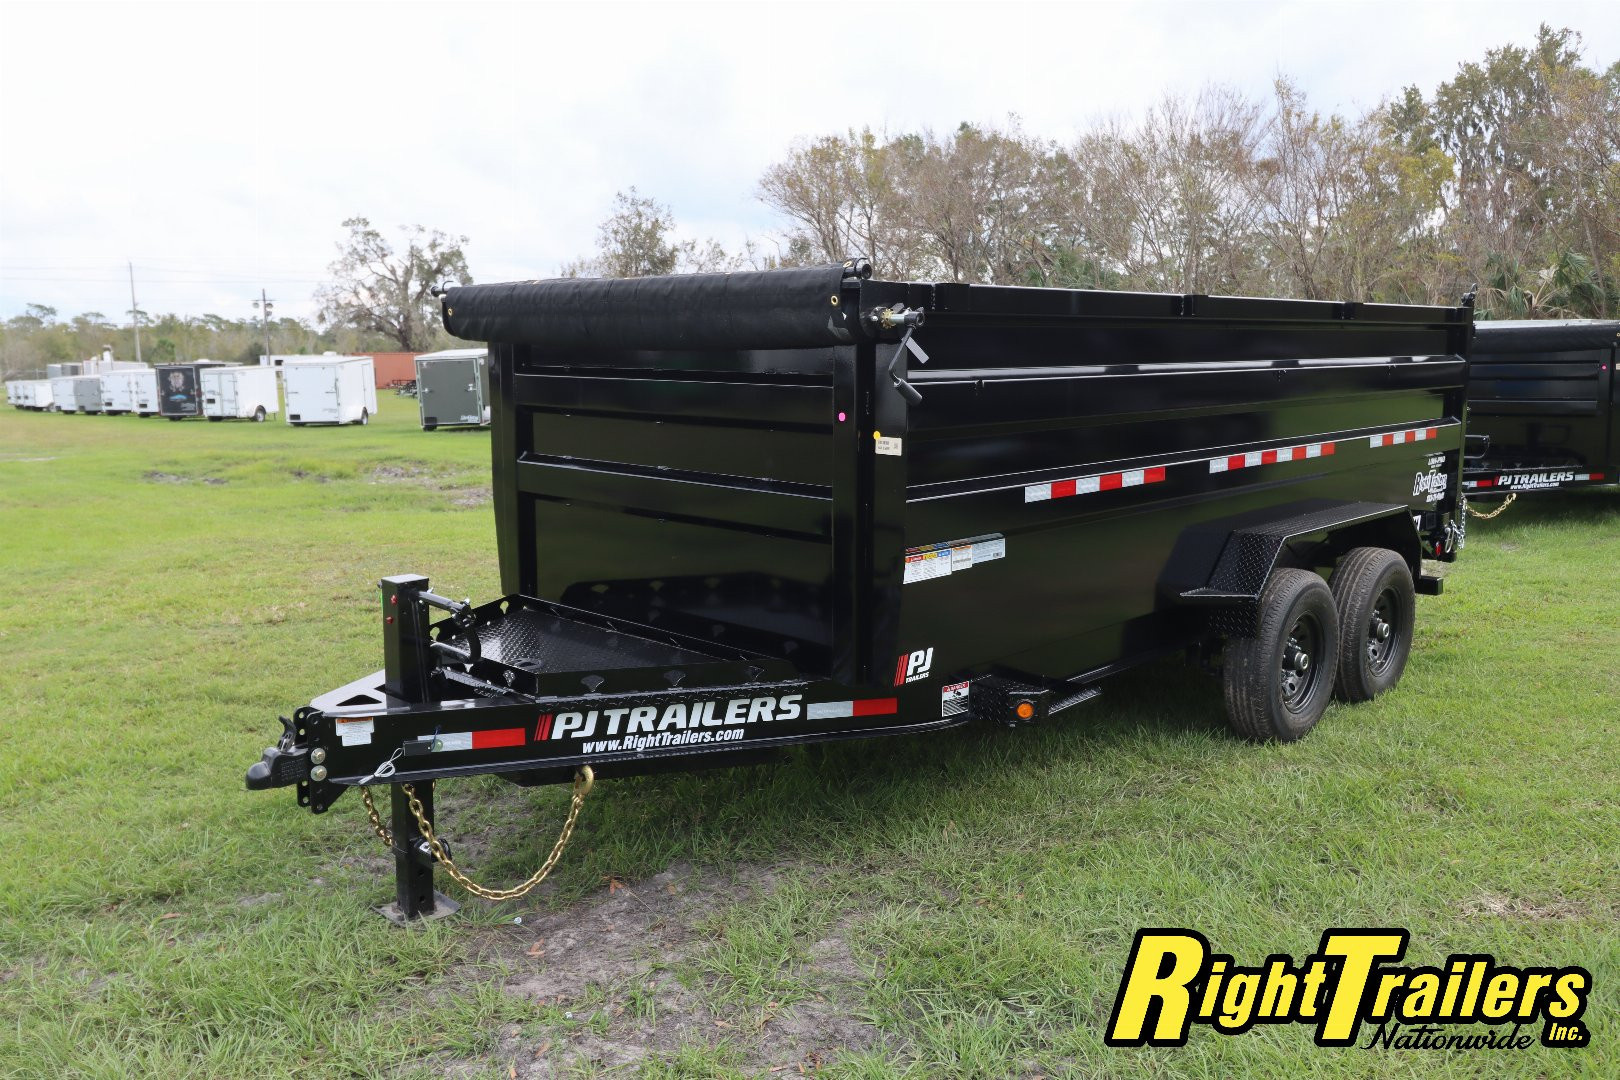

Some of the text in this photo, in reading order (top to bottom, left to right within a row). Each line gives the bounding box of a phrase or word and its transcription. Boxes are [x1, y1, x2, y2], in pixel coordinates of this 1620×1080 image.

[1498, 471, 1574, 486] PJ TRAILERS
[906, 647, 934, 676] PJ
[905, 671, 930, 684] TRAILERS
[551, 694, 803, 740] PJ TRAILERS
[582, 728, 745, 754] www.RightTrailers.com
